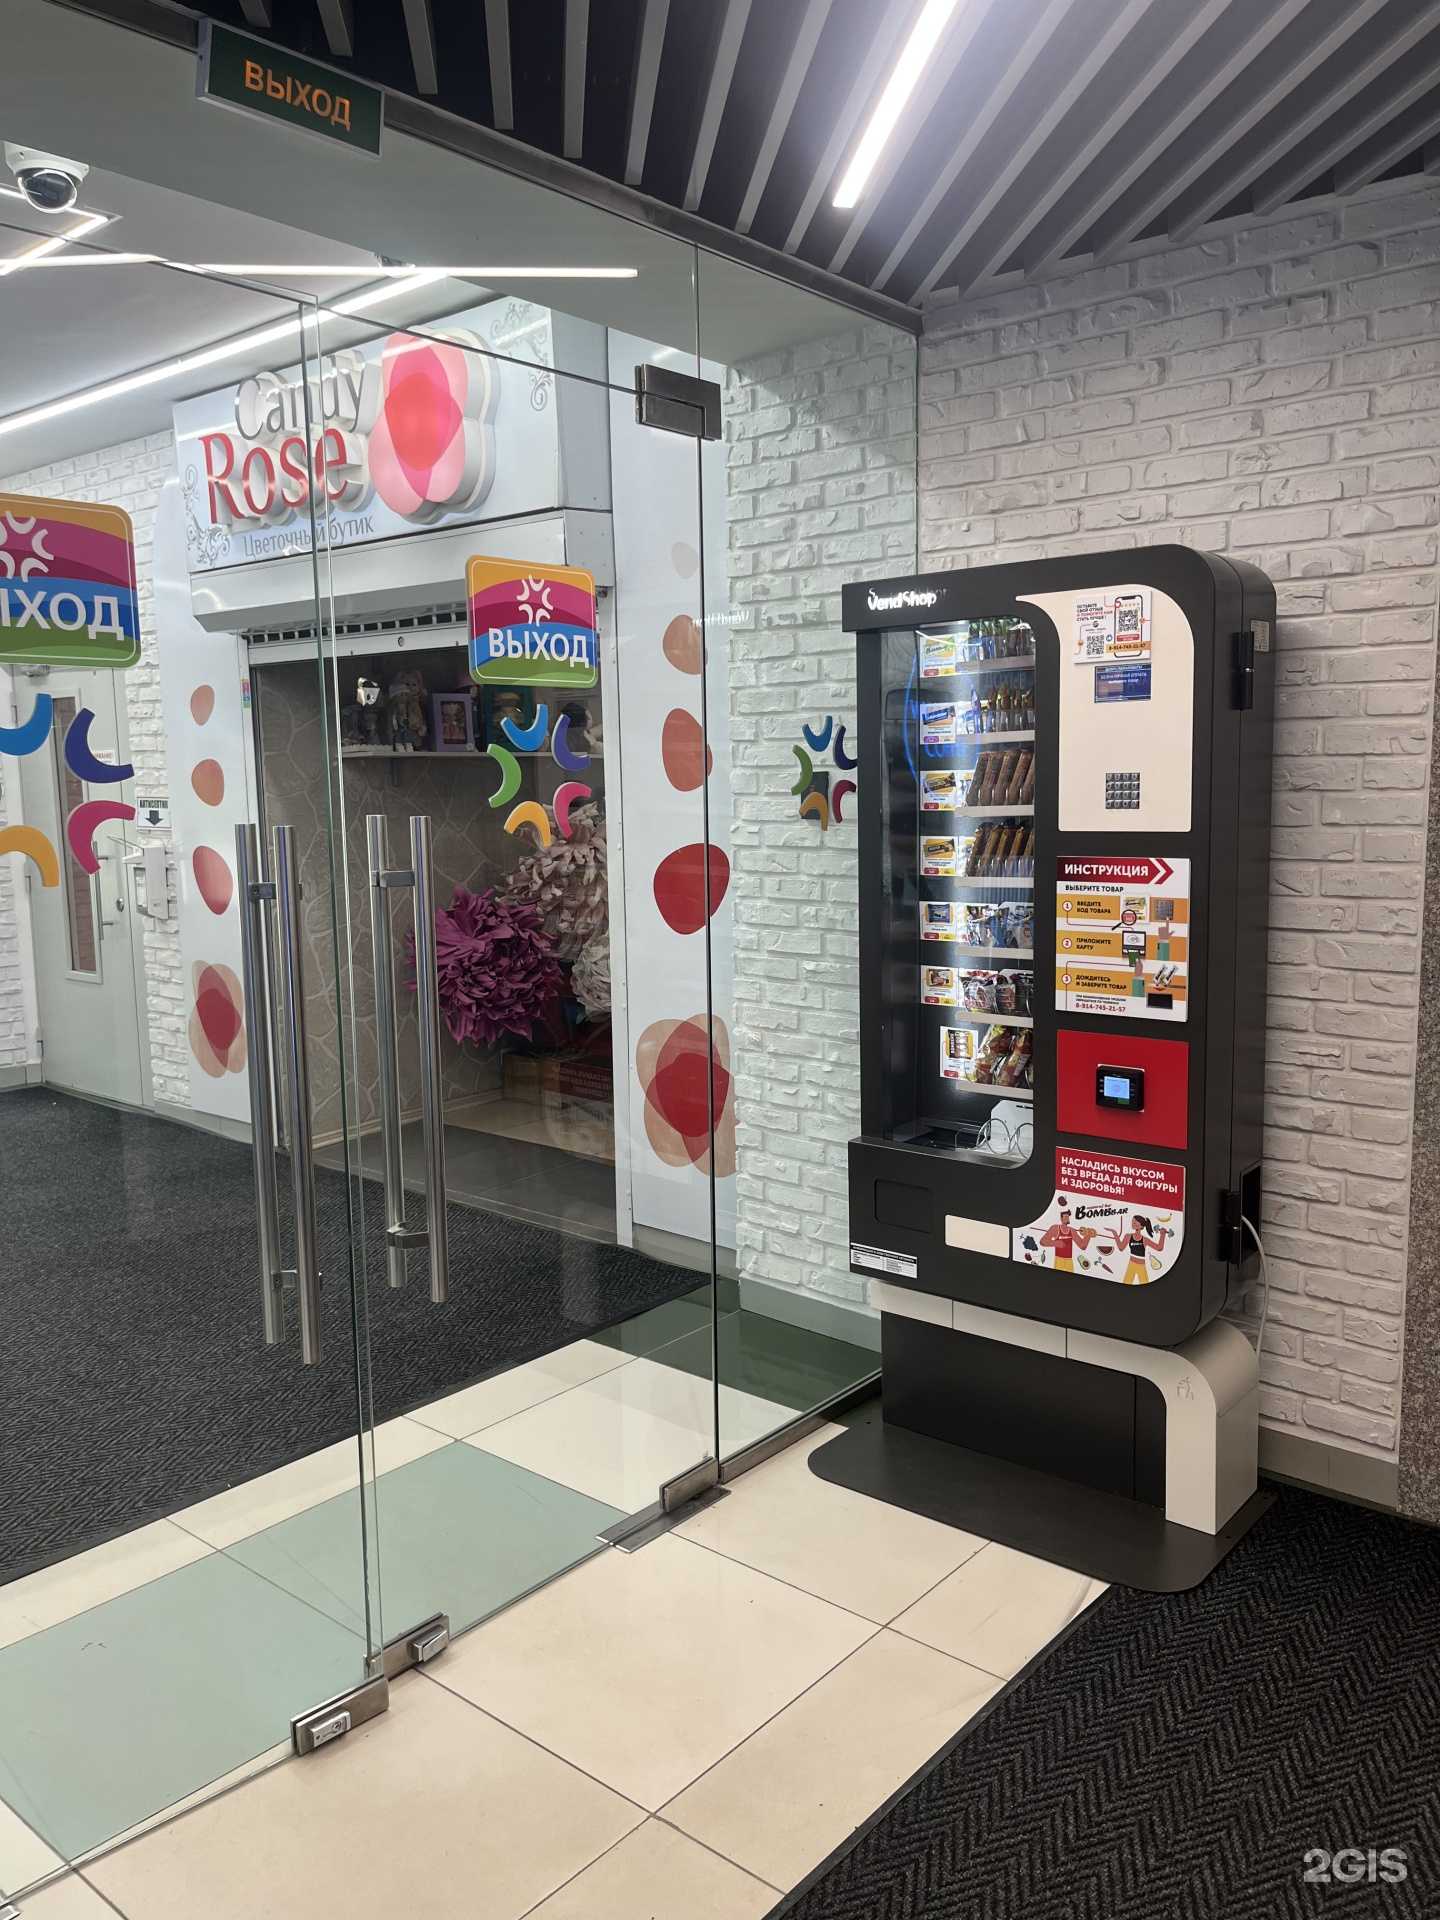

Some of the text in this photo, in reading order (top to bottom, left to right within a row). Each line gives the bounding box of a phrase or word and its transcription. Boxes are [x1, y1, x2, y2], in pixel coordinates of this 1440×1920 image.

[243, 59, 351, 132] ВЫХОД
[199, 431, 348, 524] Rose
[329, 514, 374, 542] бутик
[488, 627, 589, 669] ВЫХОД
[1064, 864, 1149, 878] ИНСТРУКЦИЯ
[1076, 937, 1111, 945] ПРИЛОЖИТЕ
[1075, 974, 1111, 982] ДОЖДИТЕСЬ
[1081, 981, 1107, 989] ЗАБЕРИТЕ
[1061, 1156, 1165, 1180] НАСЛАДИСЬ ВКУСОМ
[1061, 1167, 1178, 1193] БЕЗ ВРЕДА ДЛЯ ФИГУРЫ
[1061, 1177, 1125, 1195] И ЗДОРОВЬЯ!
